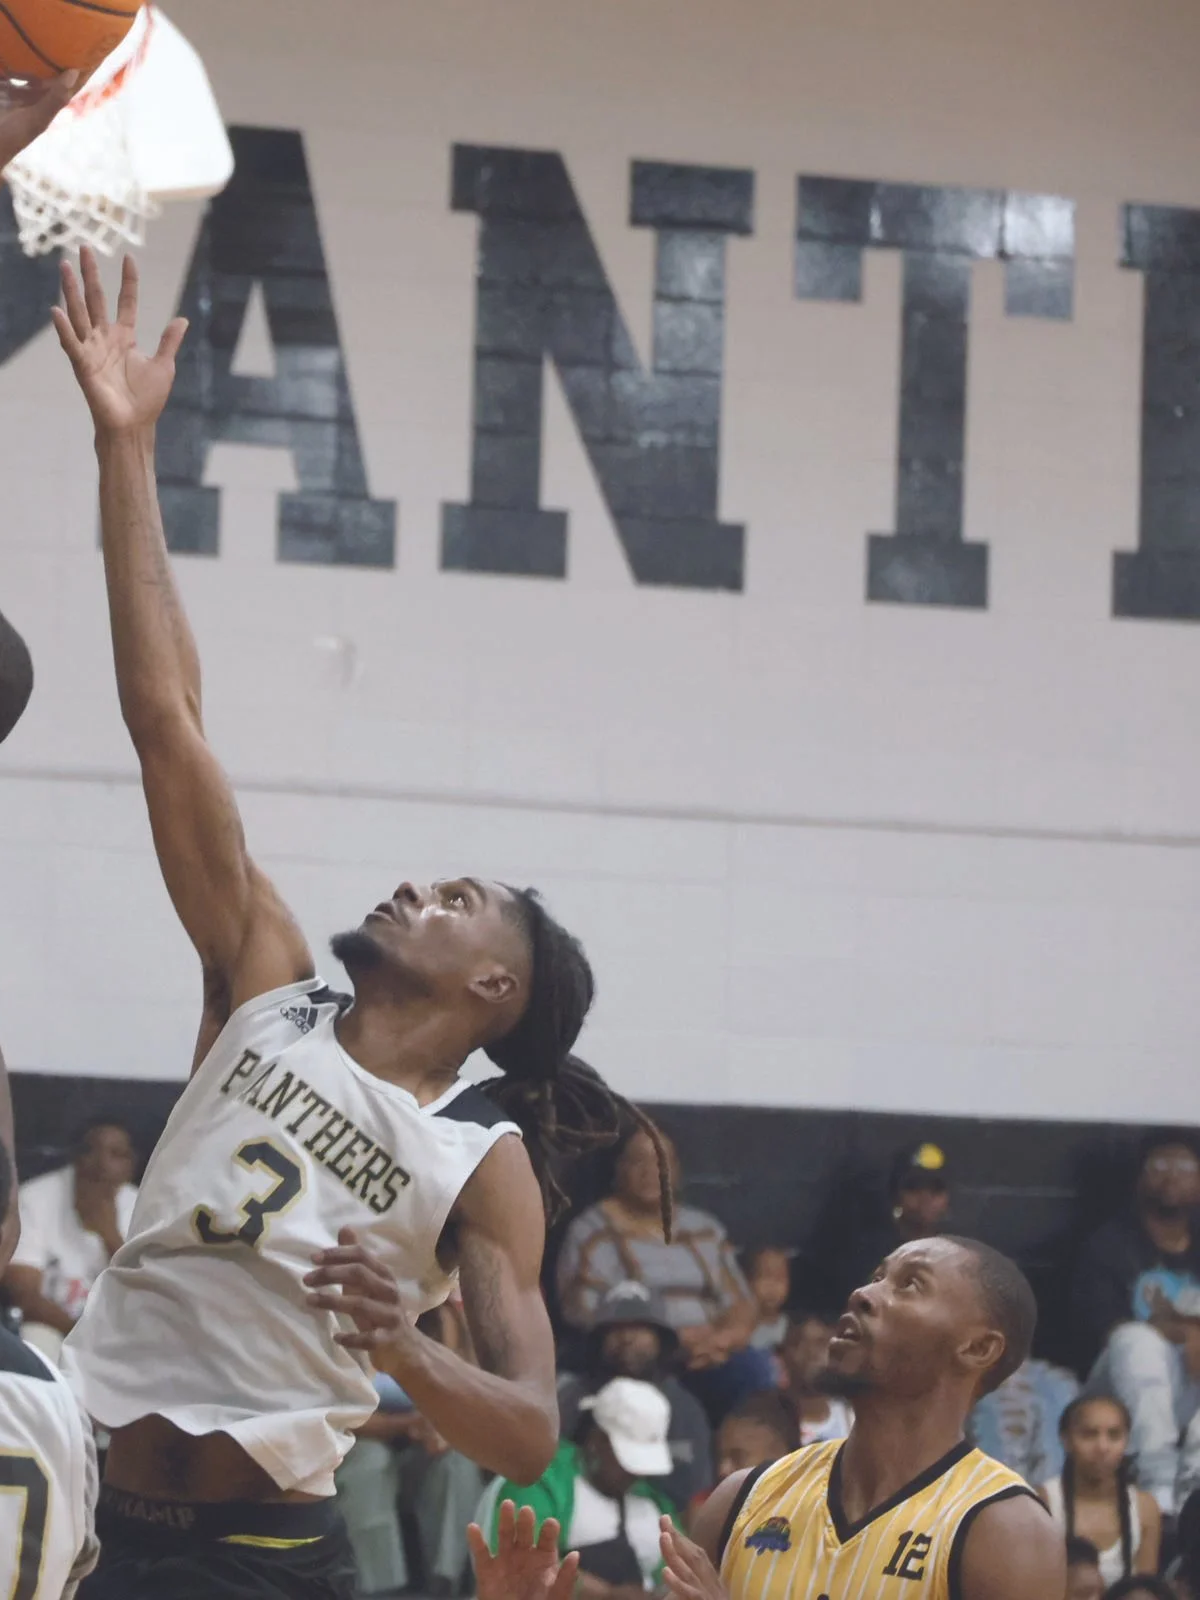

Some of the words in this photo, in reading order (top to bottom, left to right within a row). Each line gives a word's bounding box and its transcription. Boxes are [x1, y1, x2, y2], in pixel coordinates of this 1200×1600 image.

[220, 1048, 411, 1215] PANTHERS
[191, 1136, 307, 1249] 3
[881, 1530, 932, 1580] 12
